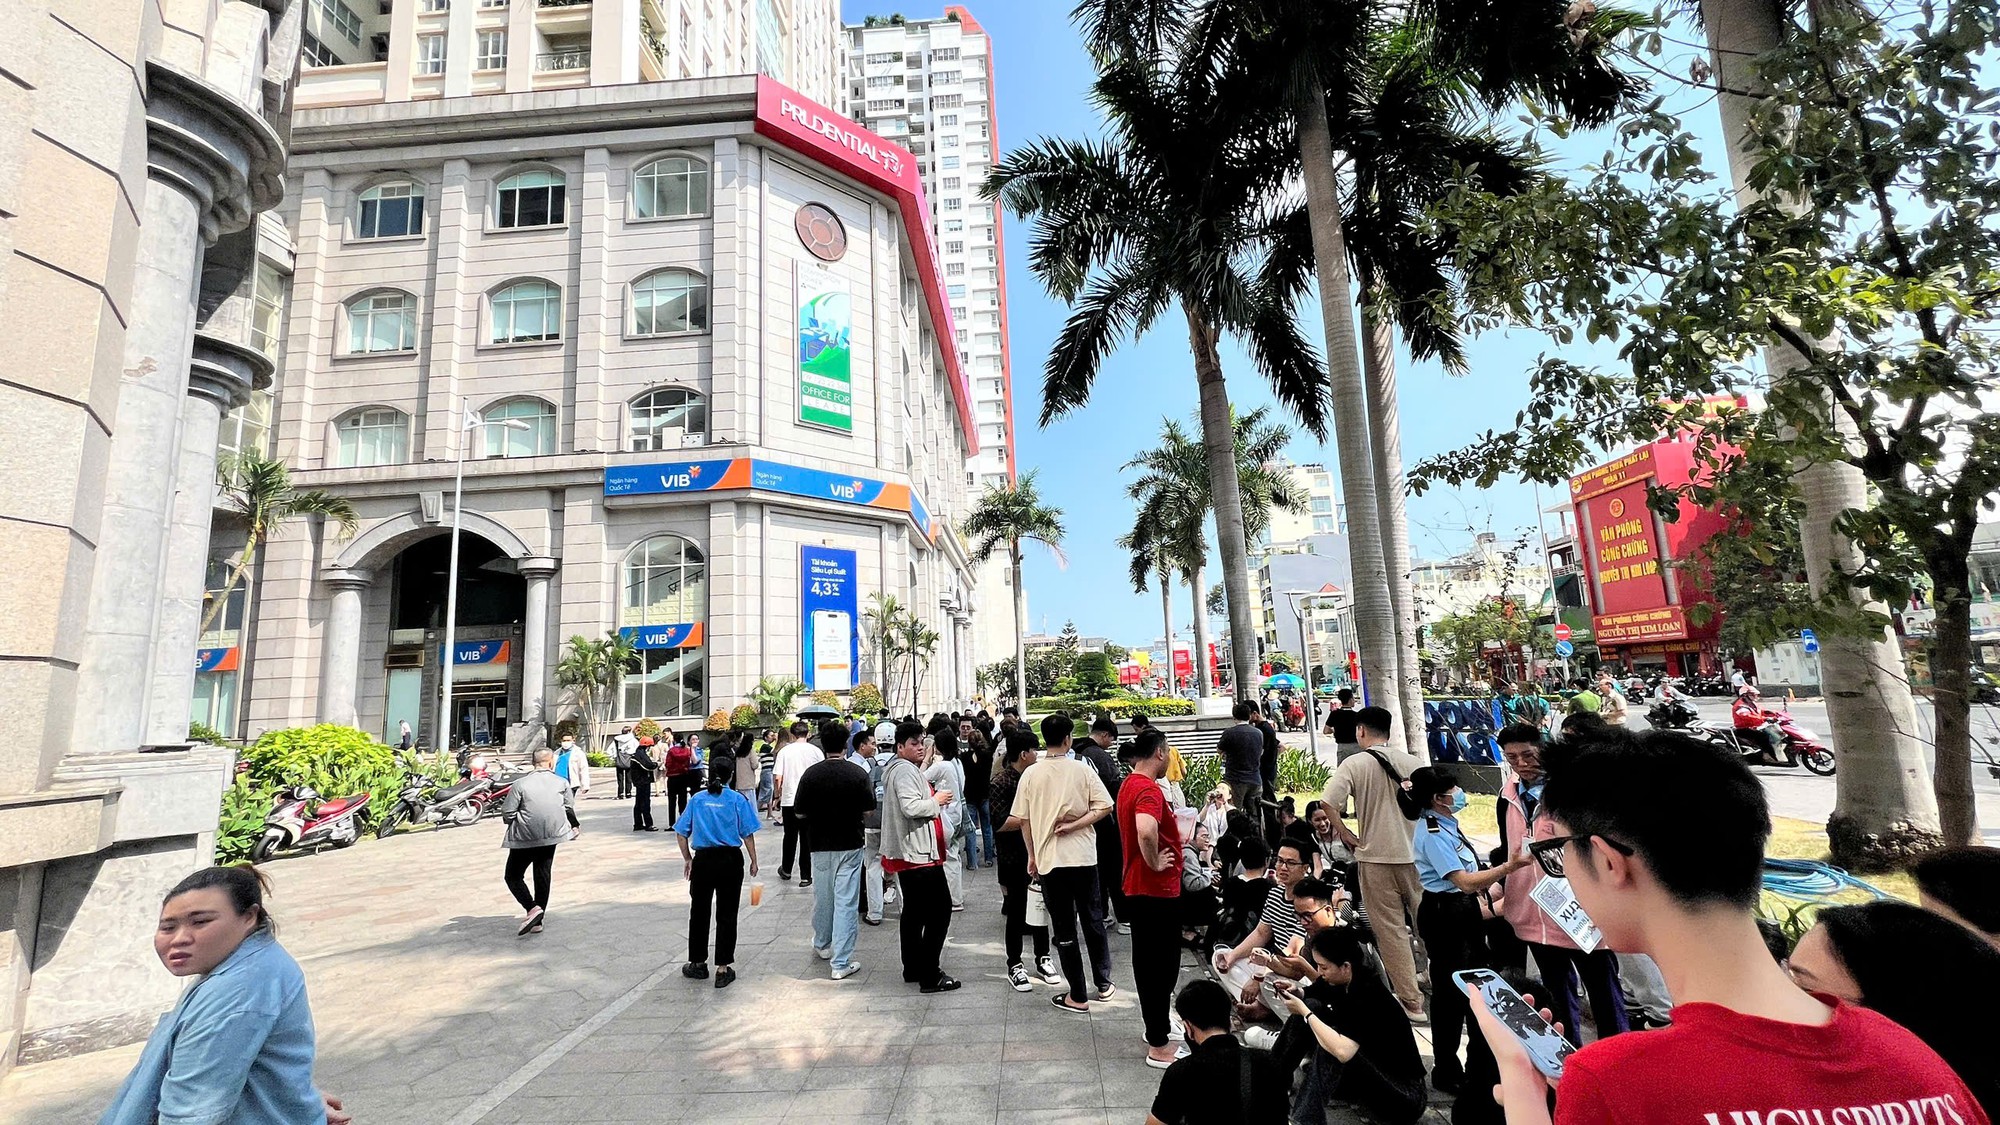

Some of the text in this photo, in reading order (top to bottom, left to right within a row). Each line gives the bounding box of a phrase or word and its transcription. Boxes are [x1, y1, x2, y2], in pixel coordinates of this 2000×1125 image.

[781, 98, 880, 164] PRUDENTIAL
[802, 385, 850, 404] OFFICE FOR
[660, 474, 691, 488] VIB
[830, 483, 855, 498] VIB
[1600, 518, 1643, 543] VĂN PHÒNG
[1600, 539, 1649, 563] CÔNG CHỨNG
[1598, 624, 1627, 638] NGUYỄN
[1627, 625, 1640, 636] THỊ
[1640, 623, 1658, 634] KIM
[1658, 621, 1682, 632] LOAN
[645, 633, 669, 645] VIB
[459, 650, 481, 661] VIB
